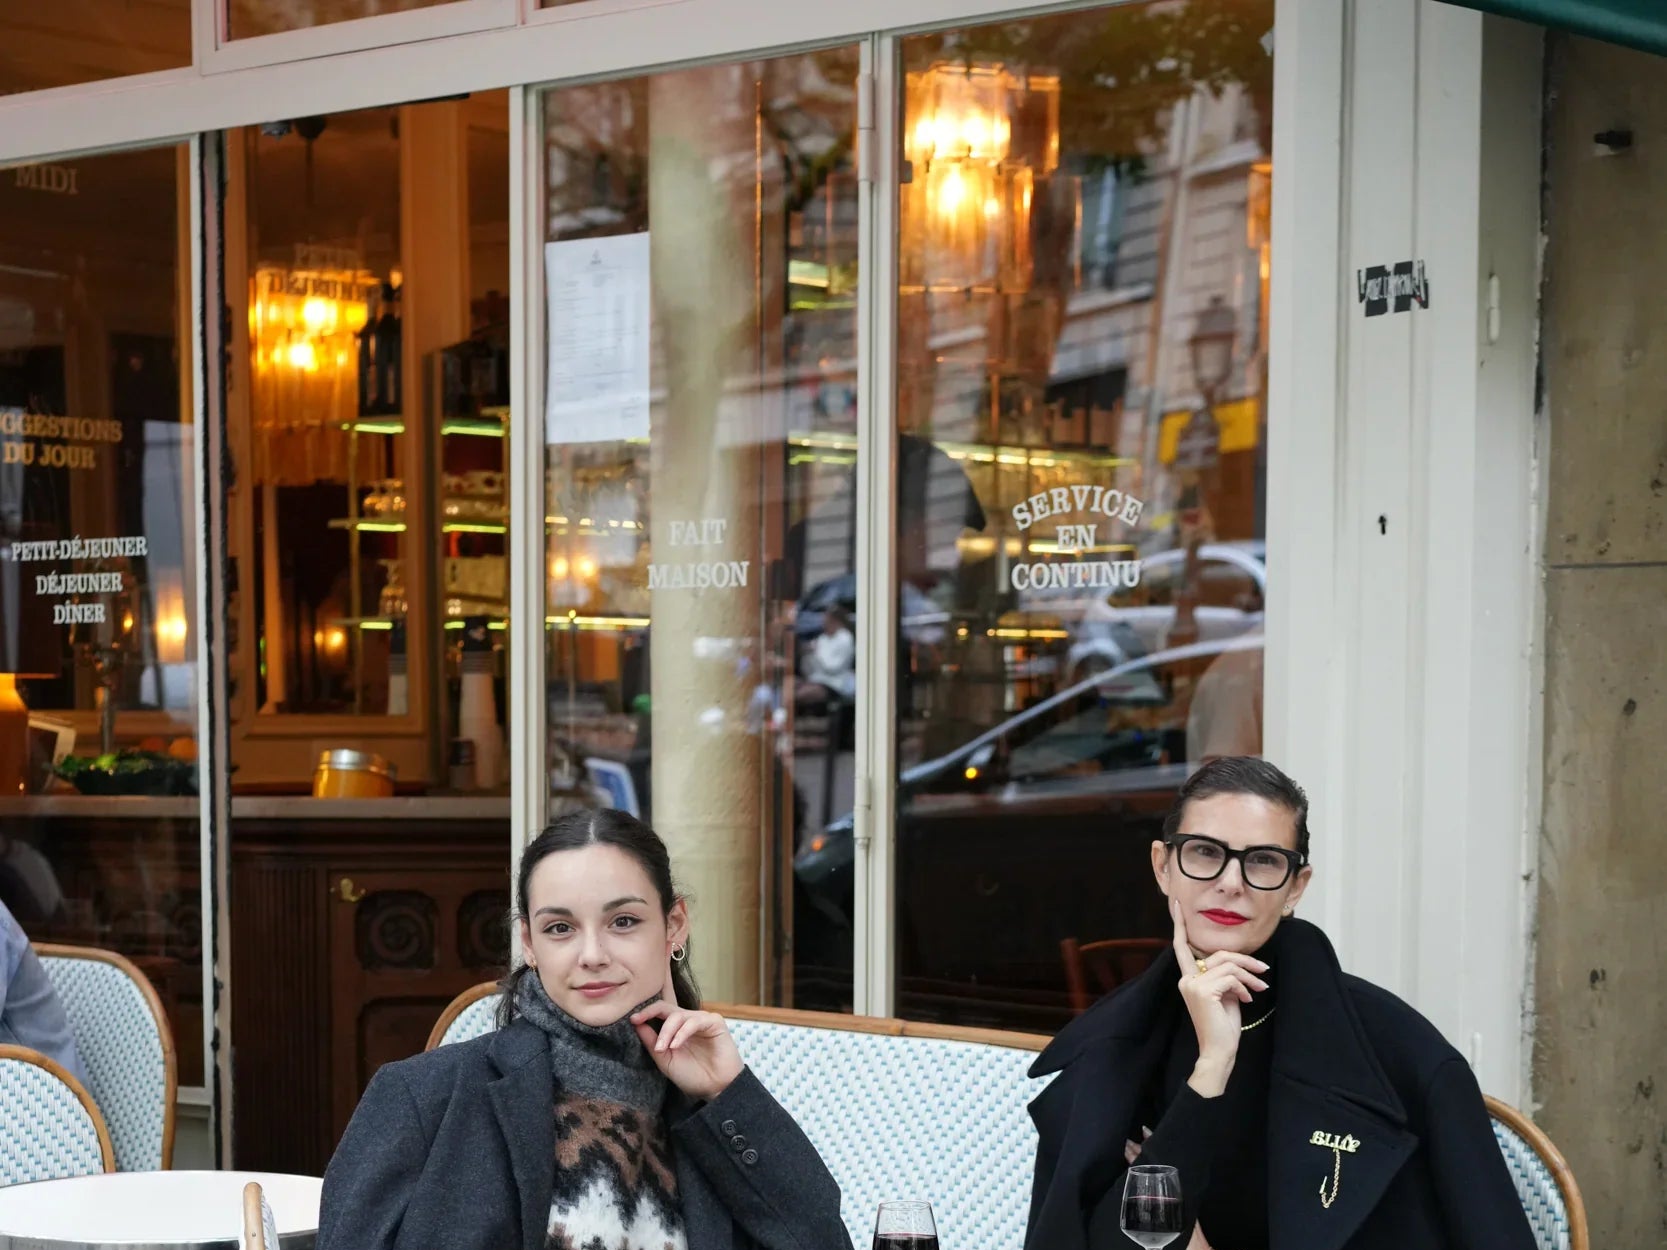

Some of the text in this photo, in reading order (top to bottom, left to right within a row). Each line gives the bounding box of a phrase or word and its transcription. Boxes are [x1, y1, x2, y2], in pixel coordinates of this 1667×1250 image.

[15, 166, 79, 195] MIDI
[0, 412, 122, 442] GGESTIONS
[3, 441, 96, 470] DU JOUR
[1012, 484, 1144, 531] SERVICE
[668, 518, 727, 547] FAIT
[1056, 524, 1098, 551] EN
[11, 535, 148, 561] PETIT-DÉJEUNER
[35, 570, 123, 595] DÉJEUNER
[647, 560, 750, 590] MAISON
[1011, 560, 1143, 591] CONTINU
